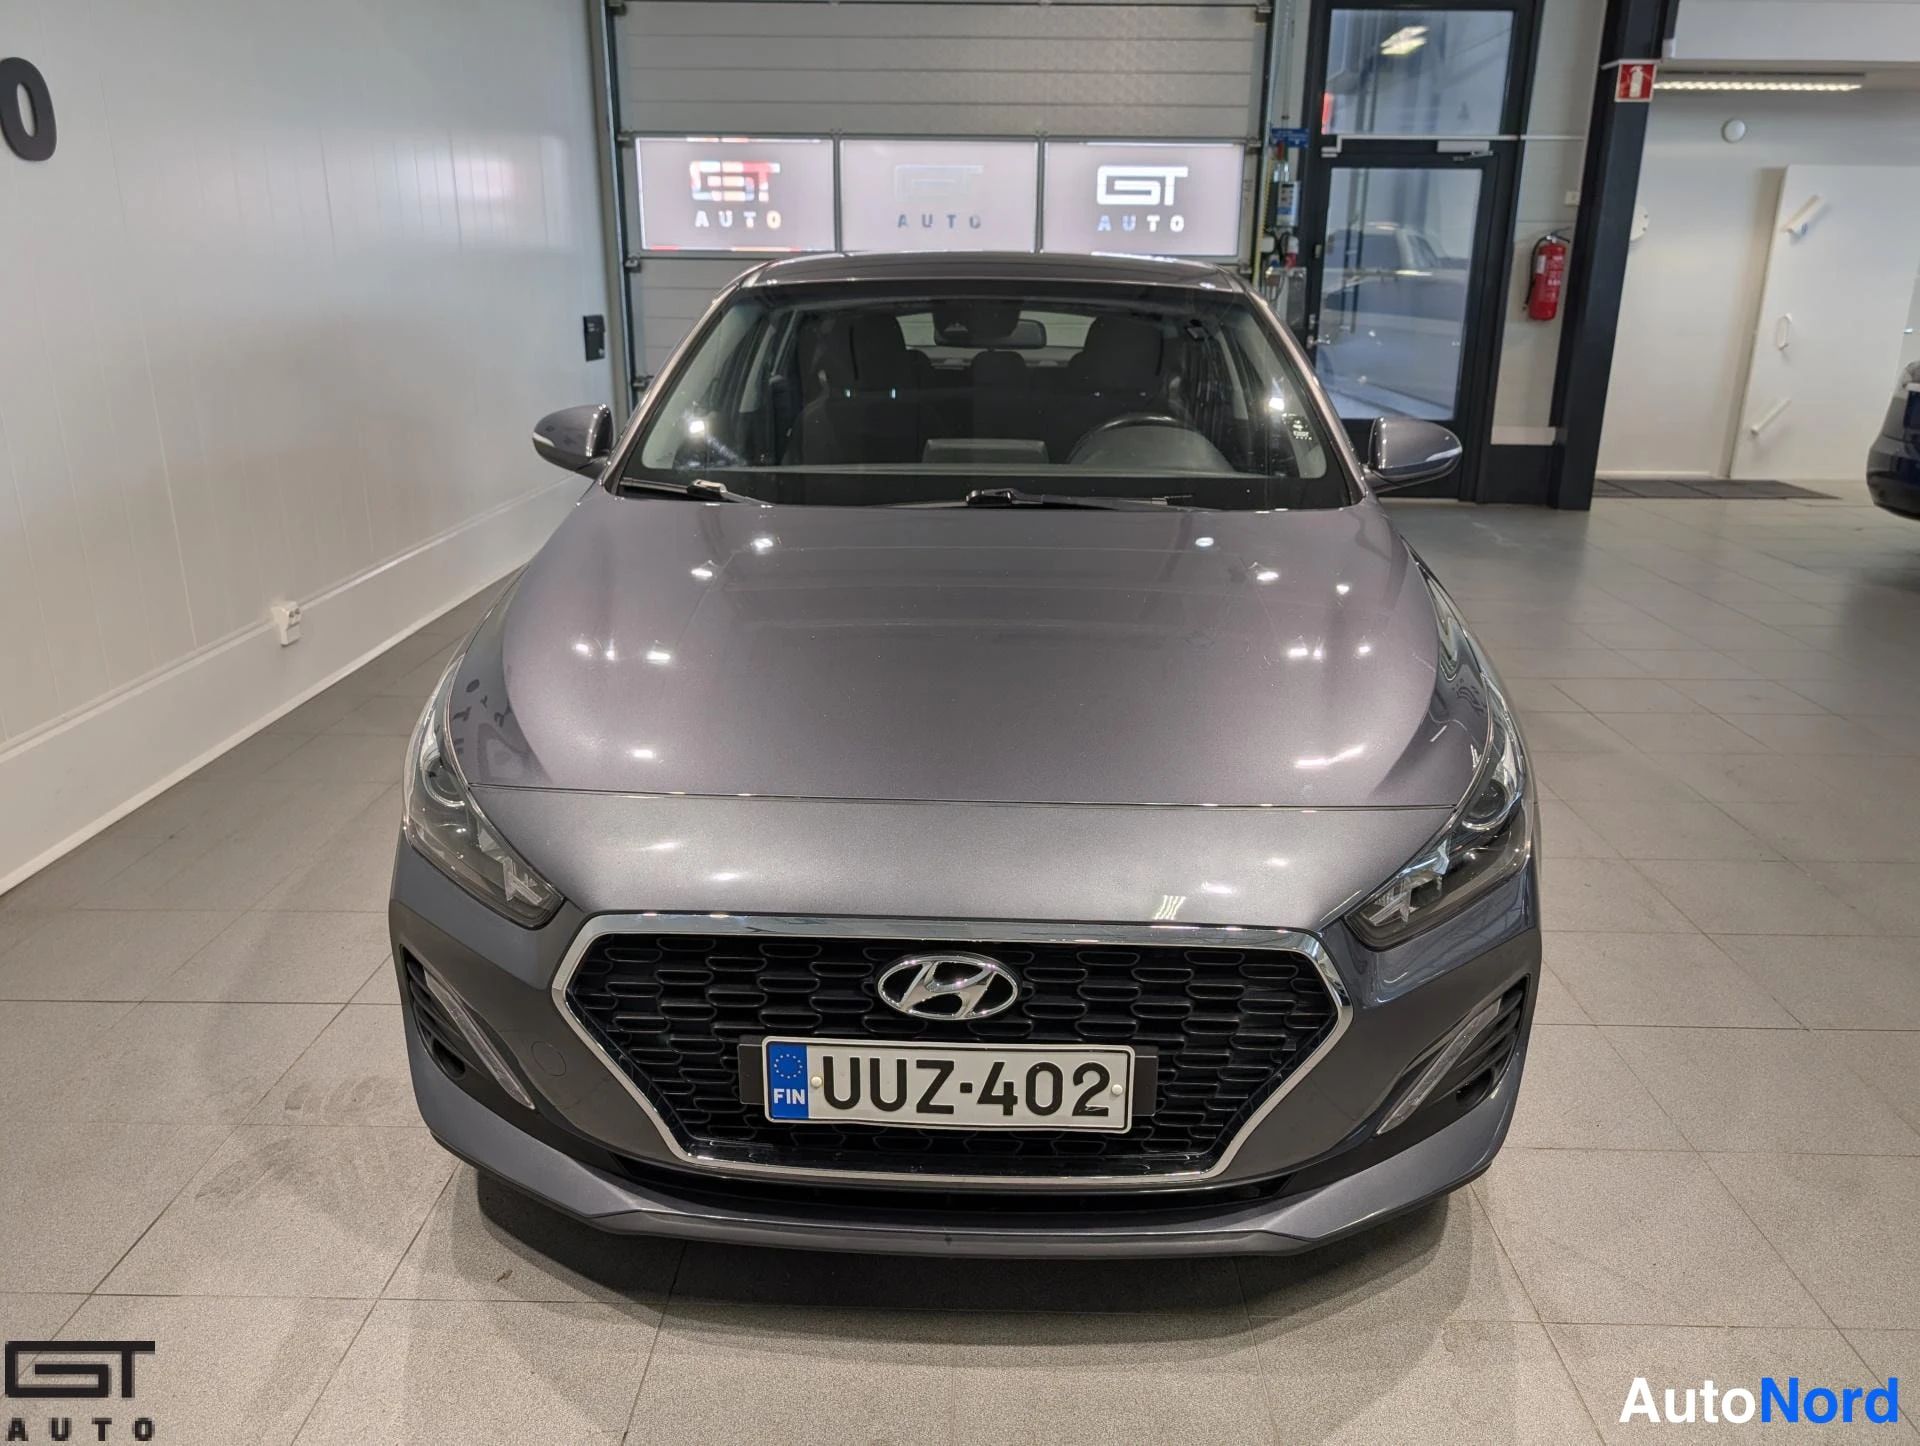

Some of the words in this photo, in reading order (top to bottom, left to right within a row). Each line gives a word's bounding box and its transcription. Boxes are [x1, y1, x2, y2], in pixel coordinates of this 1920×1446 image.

[1097, 166, 1189, 206] GT
[695, 209, 782, 229] AUTO
[897, 213, 982, 229] AUTO
[1097, 214, 1185, 232] AUTO
[821, 1055, 1112, 1117] UUZ-402
[773, 1087, 806, 1105] FIN
